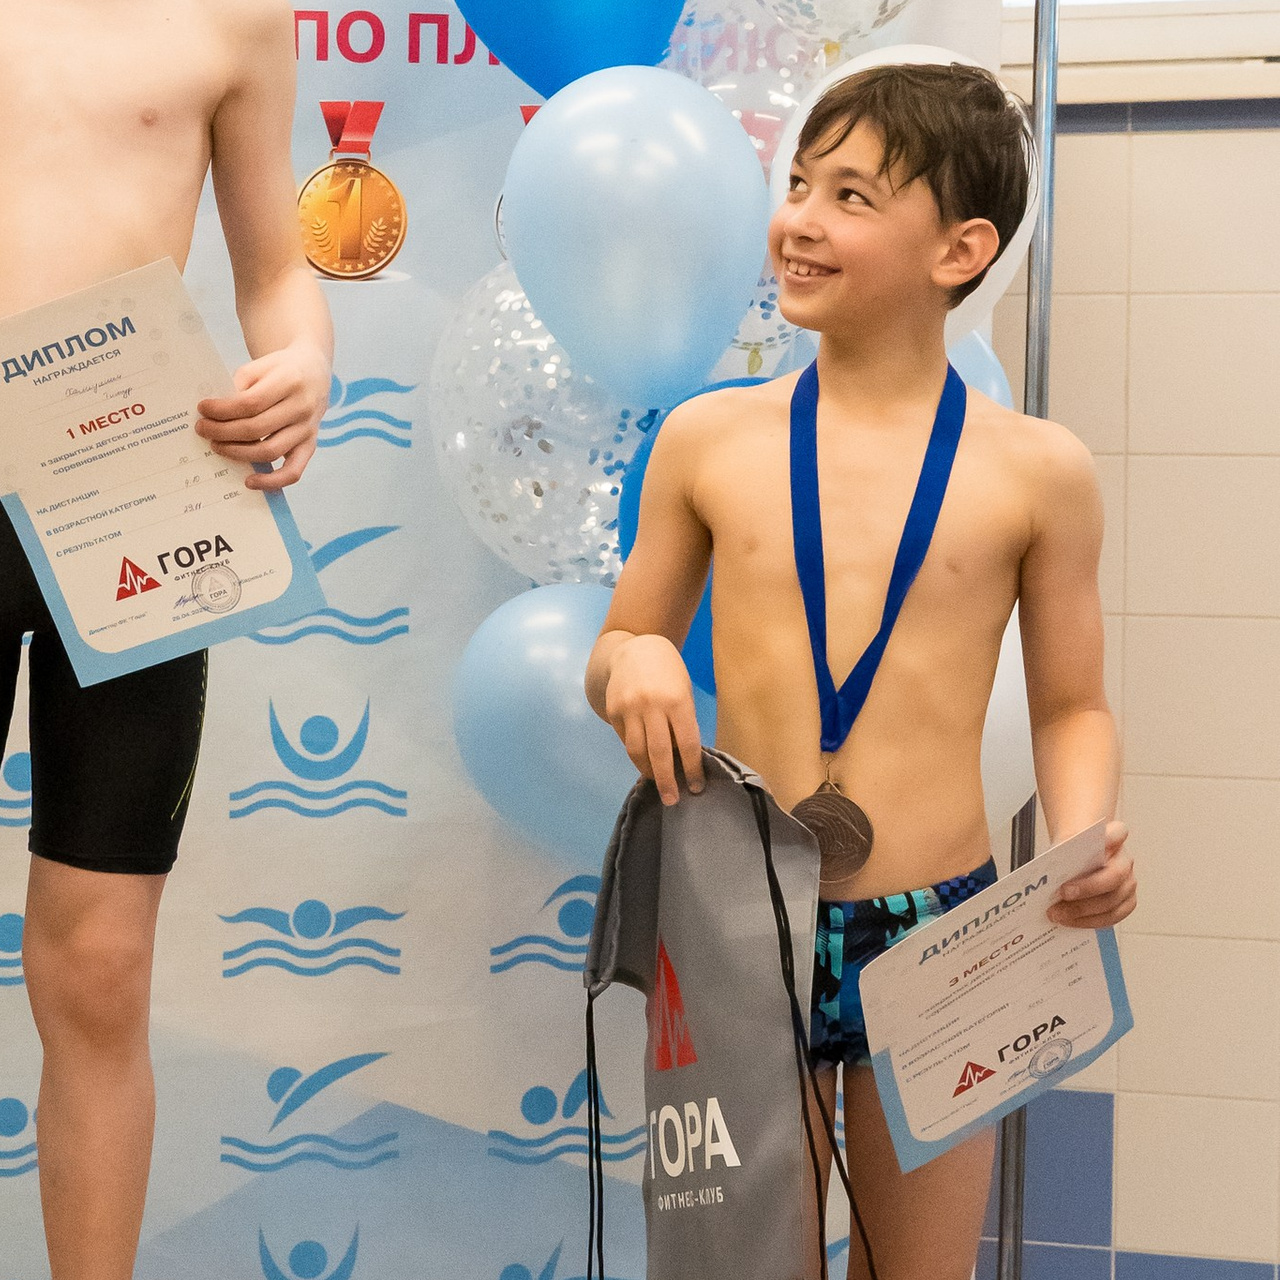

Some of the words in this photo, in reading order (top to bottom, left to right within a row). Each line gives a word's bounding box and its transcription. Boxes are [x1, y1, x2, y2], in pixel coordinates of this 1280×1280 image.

[294, 10, 385, 63] ПО
[1, 316, 136, 383] ДИПЛОМ
[33, 348, 122, 386] НАГРАЖДАЕТСЯ
[47, 444, 94, 466] закрытых
[95, 410, 190, 450] детско-юношеских
[66, 428, 76, 440] 1
[79, 403, 146, 436] МЕСТО
[52, 445, 127, 476] соревнованиях
[128, 440, 140, 450] по
[140, 422, 190, 445] плаванию
[36, 506, 49, 517] НА
[49, 488, 100, 513] ДИСТАНЦИИ
[53, 510, 108, 536] ВОЗРАСТНОЙ
[108, 493, 157, 515] КАТЕГОРИИ
[63, 530, 122, 556] РЕЗУЛЬТАТОМ
[157, 534, 235, 575] ГОРА
[209, 588, 228, 600] ГОРА
[919, 875, 1048, 965] ДИПЛОМ
[949, 976, 960, 988] 3
[963, 934, 1025, 979] МЕСТО
[997, 1015, 1067, 1063] ГОРА
[650, 1097, 742, 1180] ГОРА
